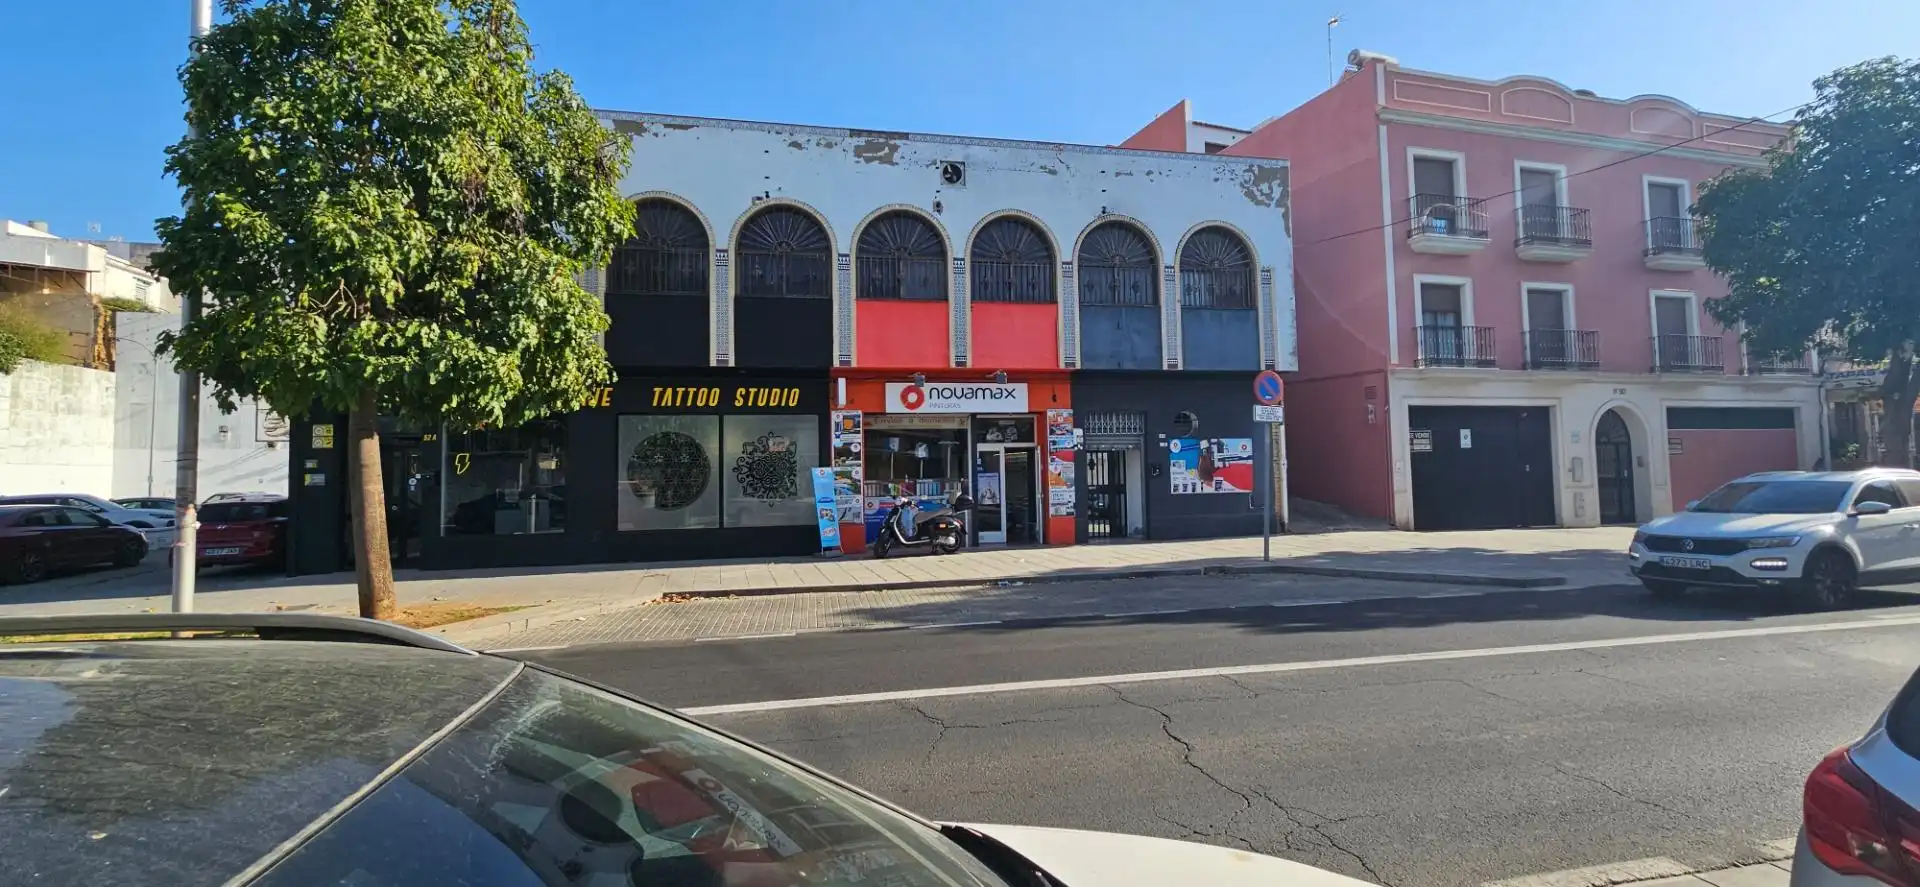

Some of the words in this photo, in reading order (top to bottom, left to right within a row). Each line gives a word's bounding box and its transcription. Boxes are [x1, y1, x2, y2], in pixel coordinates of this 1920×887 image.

[652, 387, 720, 407] TATTOO
[734, 387, 800, 407] STUDIO
[929, 387, 1016, 400] novamax
